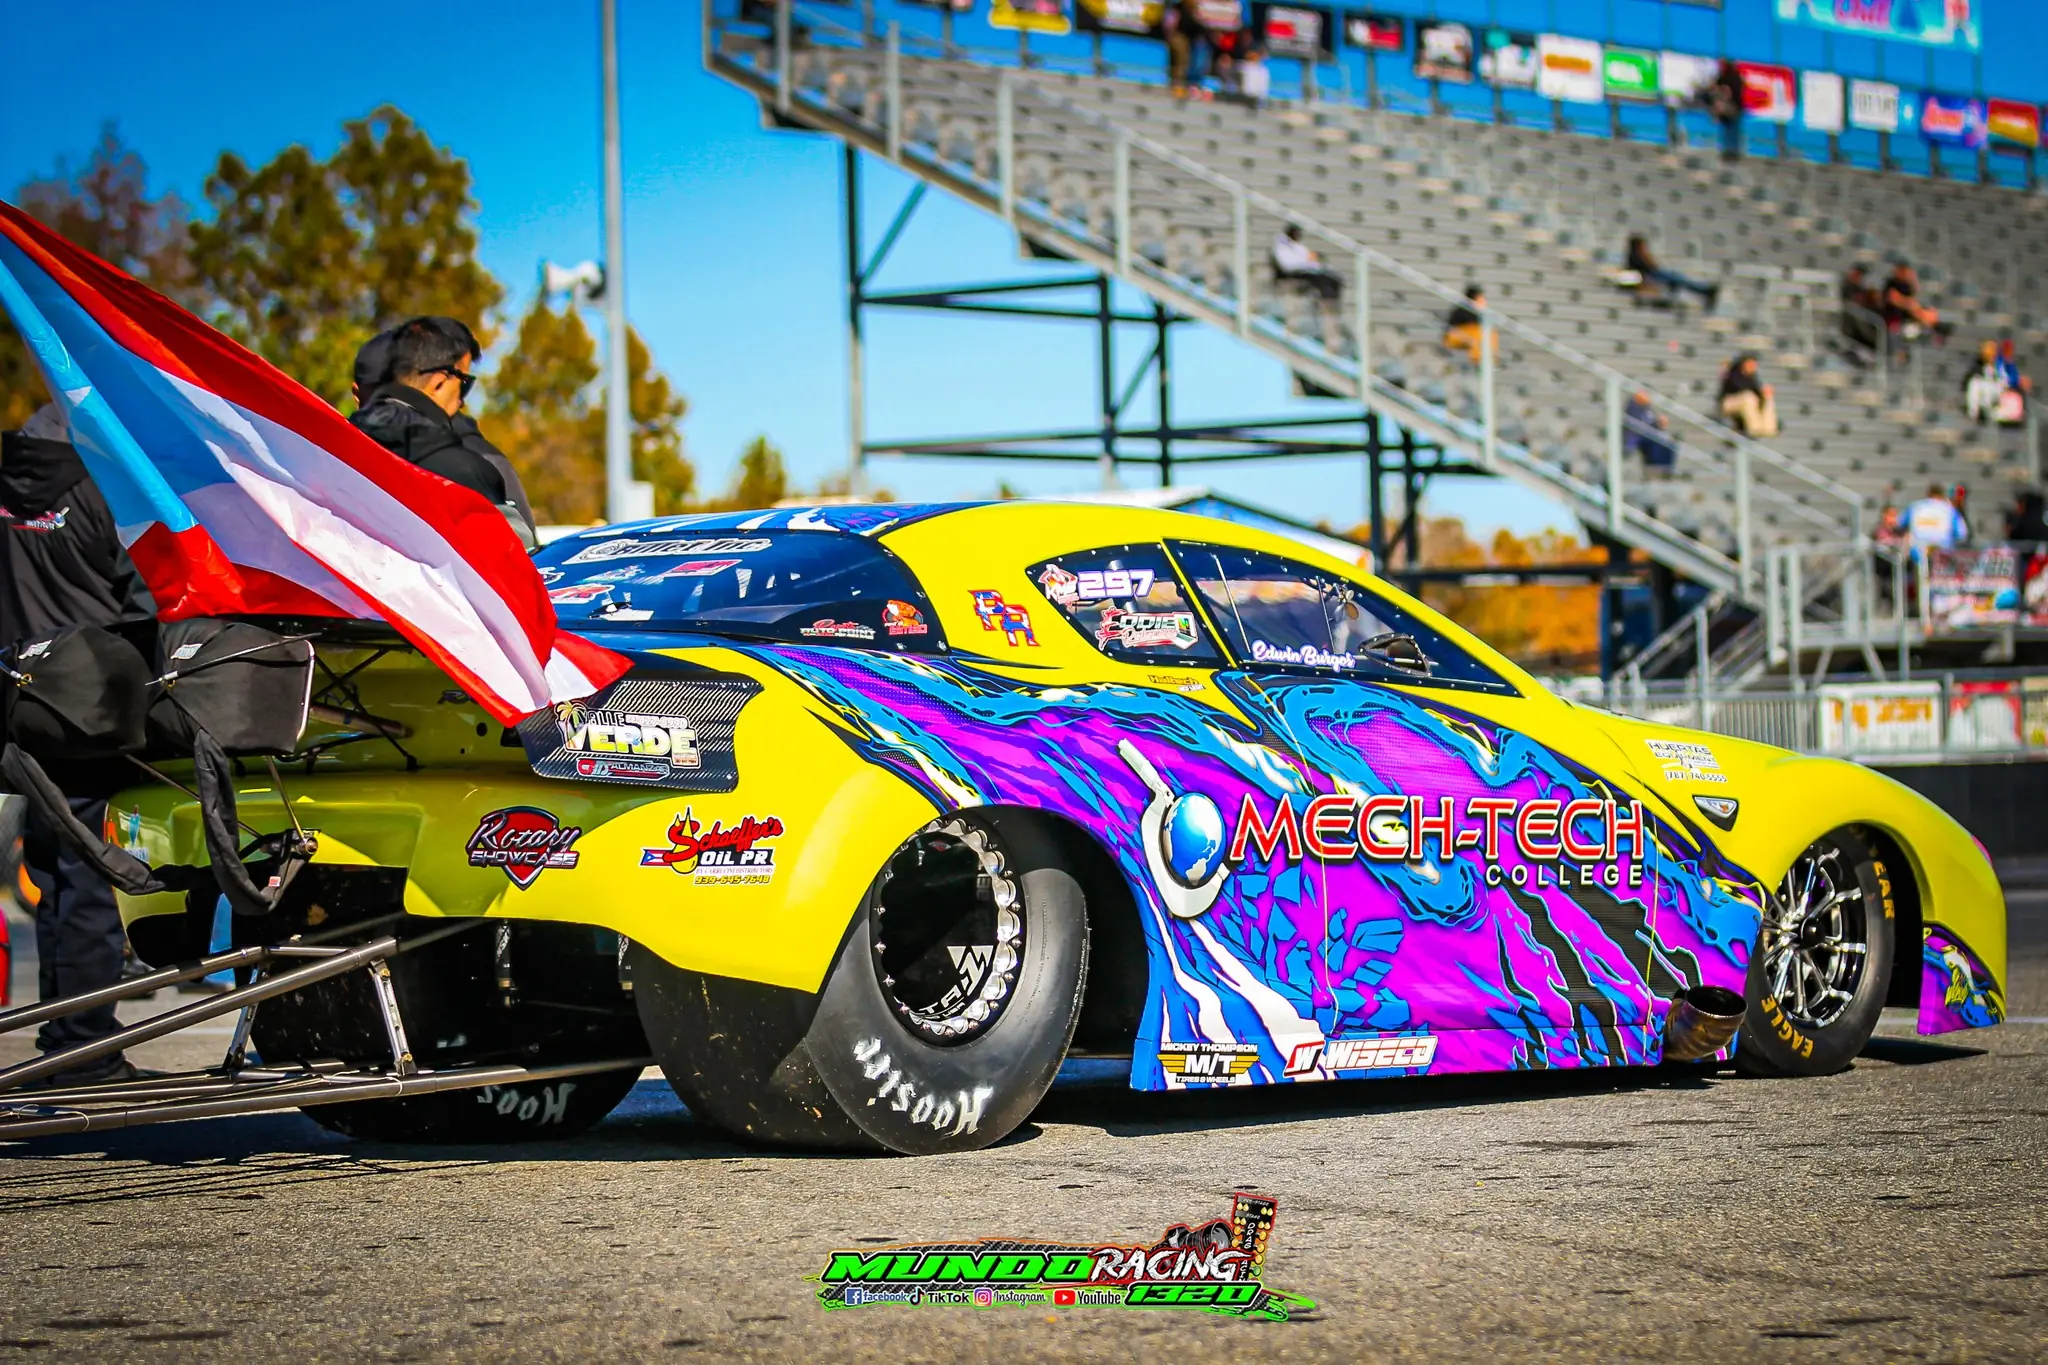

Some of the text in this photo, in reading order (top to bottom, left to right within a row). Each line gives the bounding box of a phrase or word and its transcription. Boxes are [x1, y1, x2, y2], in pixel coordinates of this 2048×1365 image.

[1077, 568, 1155, 600] 297
[1252, 640, 1355, 671] Edwin Burgos
[557, 719, 698, 755] VERDE
[466, 811, 581, 852] Rotary
[1230, 793, 1644, 862] MECH-TECH
[470, 850, 579, 867] SHOWCASE
[700, 850, 768, 865] OIL PR
[1485, 864, 1643, 886] COLLEGE
[1760, 994, 1814, 1059] EAGLE
[1161, 1043, 1258, 1053] MICKEY THOMPSON
[1184, 1053, 1236, 1076] M/T
[1206, 1076, 1236, 1084] WHEELS
